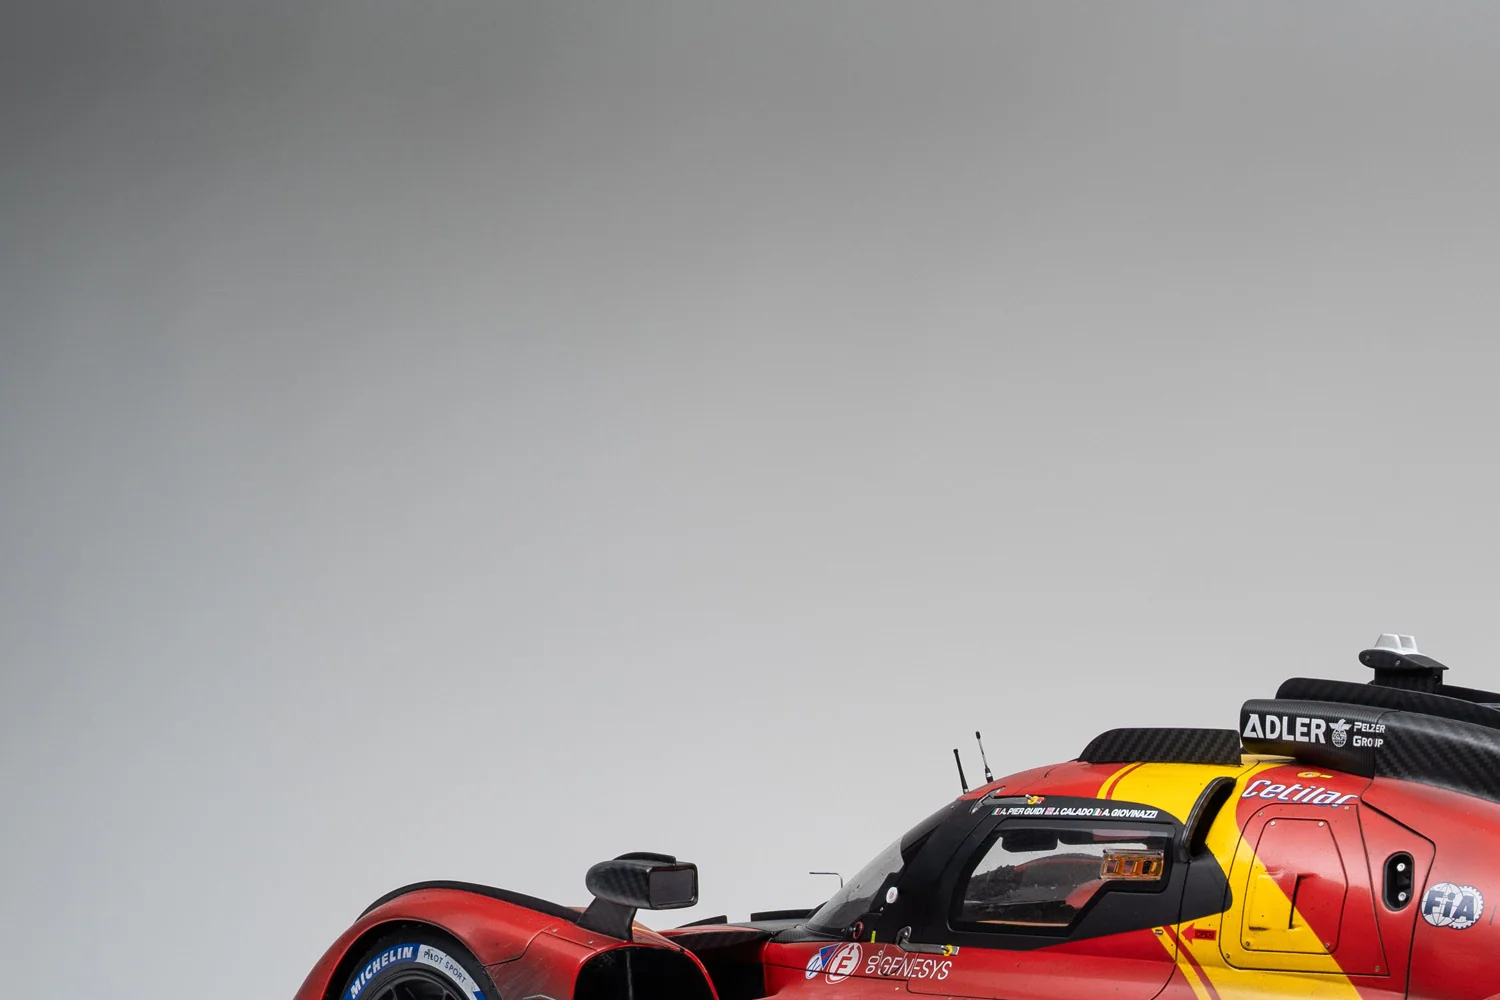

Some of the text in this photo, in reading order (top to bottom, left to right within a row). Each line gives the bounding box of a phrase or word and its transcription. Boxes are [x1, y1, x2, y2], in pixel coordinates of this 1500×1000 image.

[1243, 713, 1326, 744] ADLER
[1353, 721, 1386, 734] PELZER
[1241, 779, 1359, 808] Cetilar
[1007, 807, 1024, 815] PIER
[1024, 807, 1045, 816] GUIDI
[1060, 808, 1094, 817] CALADO
[1111, 808, 1158, 819] GIOVINAZZI
[350, 946, 414, 999] MICHELIN
[423, 950, 467, 984] PILOT SPORT
[877, 955, 952, 980] GENESYS
